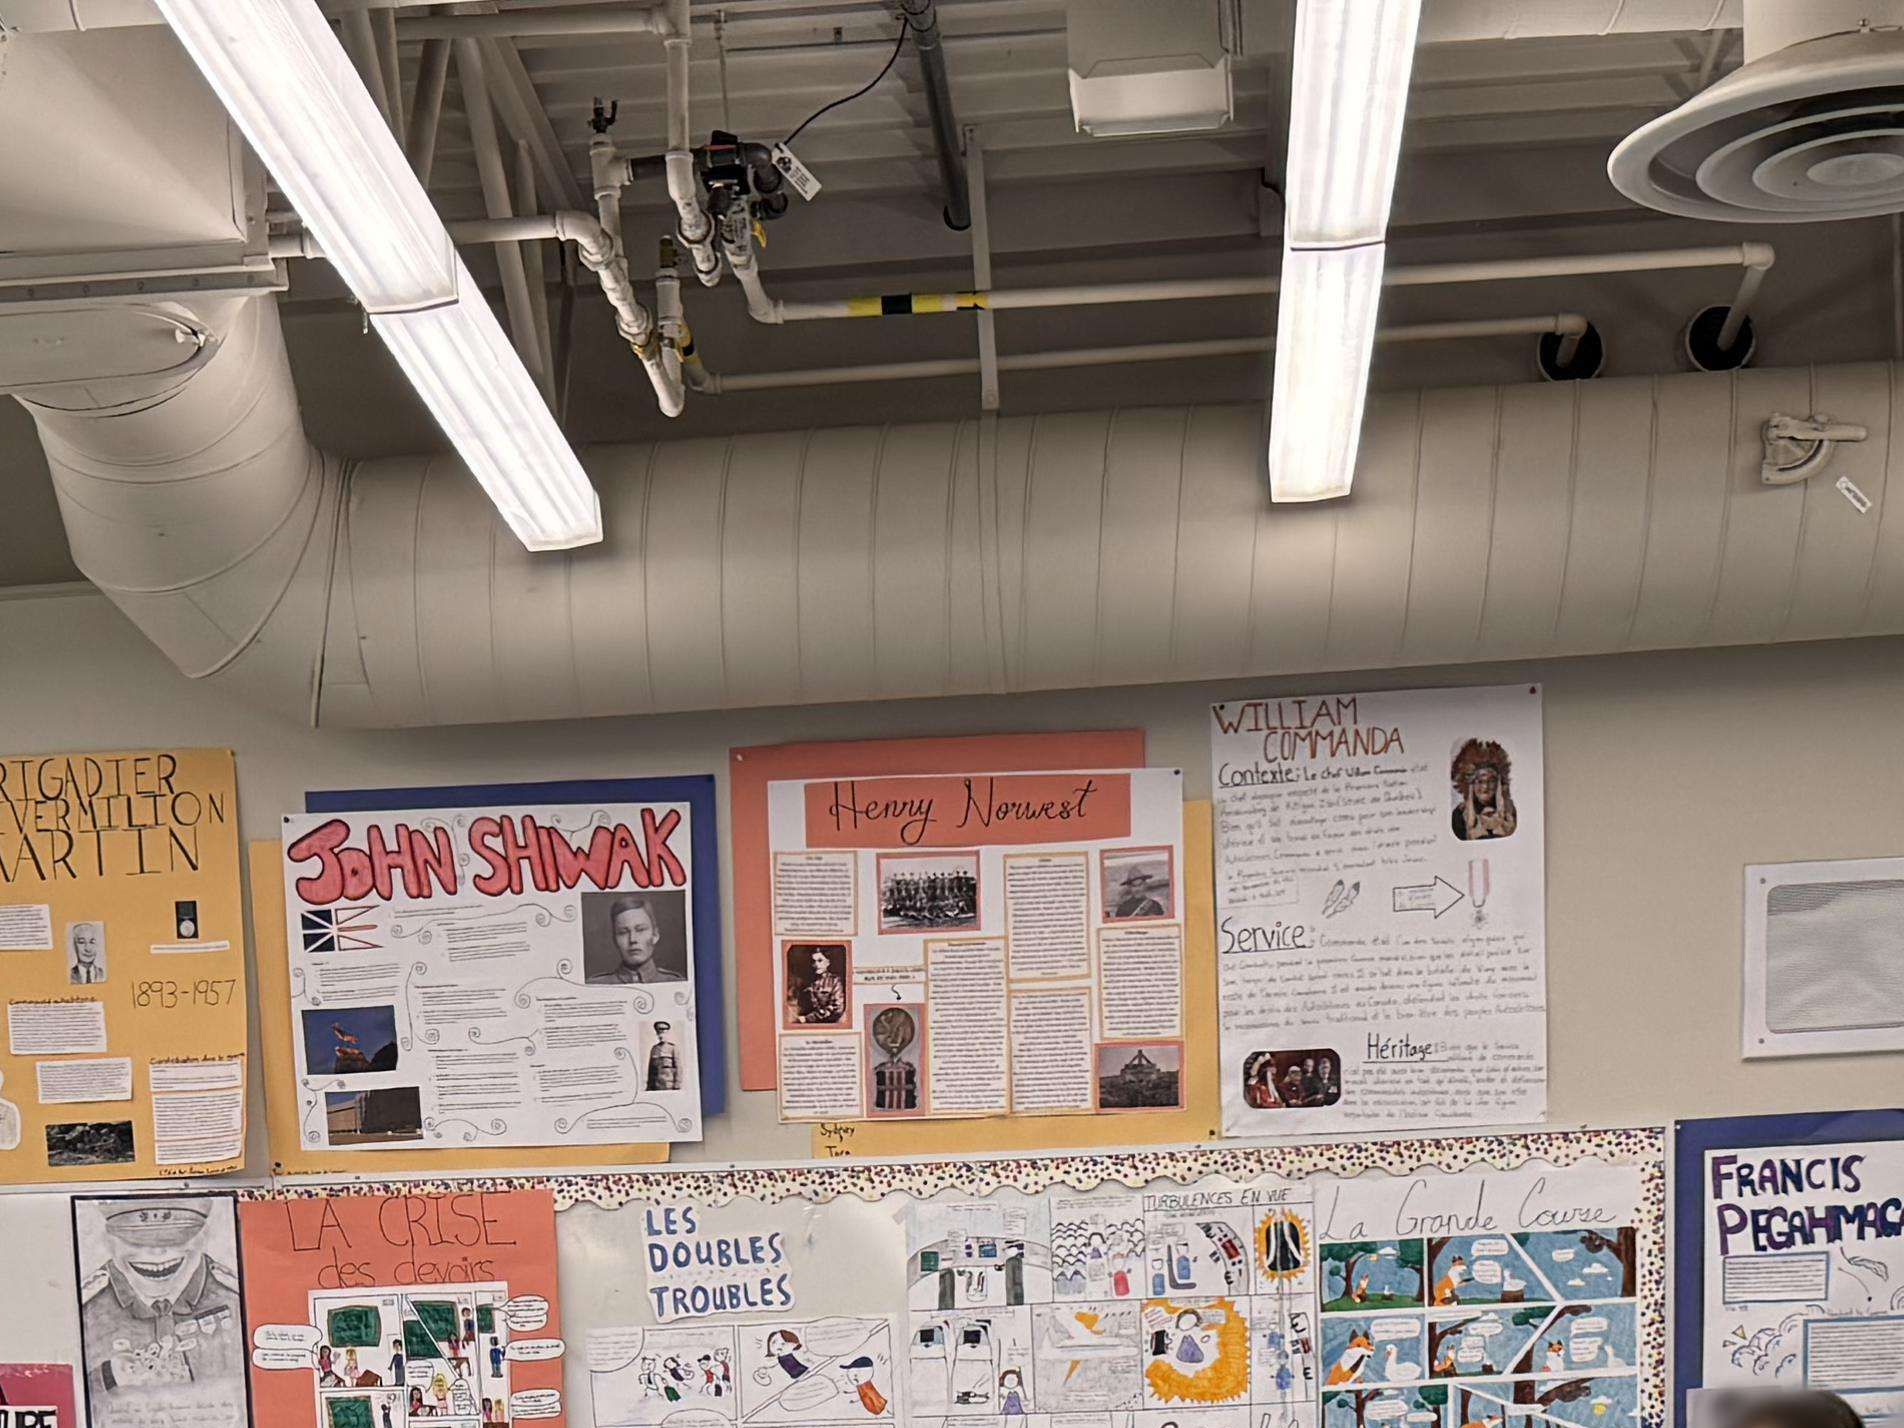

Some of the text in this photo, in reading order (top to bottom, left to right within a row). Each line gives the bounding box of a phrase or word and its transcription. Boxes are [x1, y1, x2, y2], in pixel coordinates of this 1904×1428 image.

[1212, 697, 1358, 735] WILLIAM
[1264, 727, 1405, 764] COMMANDA
[828, 778, 1097, 846] Henry Norwest
[287, 819, 458, 906] JOHN
[468, 807, 688, 897] SHIWAK
[131, 978, 237, 1009] 1893-1957
[1144, 1187, 1293, 1210] TURBULENCES EN VUE
[1711, 1154, 1866, 1200] FRANCIS
[284, 1190, 518, 1252] LA CRISE
[645, 1206, 697, 1237] LES
[1319, 1185, 1368, 1240] La
[1395, 1179, 1499, 1236] Grande
[317, 1246, 497, 1290] des devoirs
[648, 1232, 783, 1273] DOUBLES
[649, 1273, 792, 1318] TROUBLES
